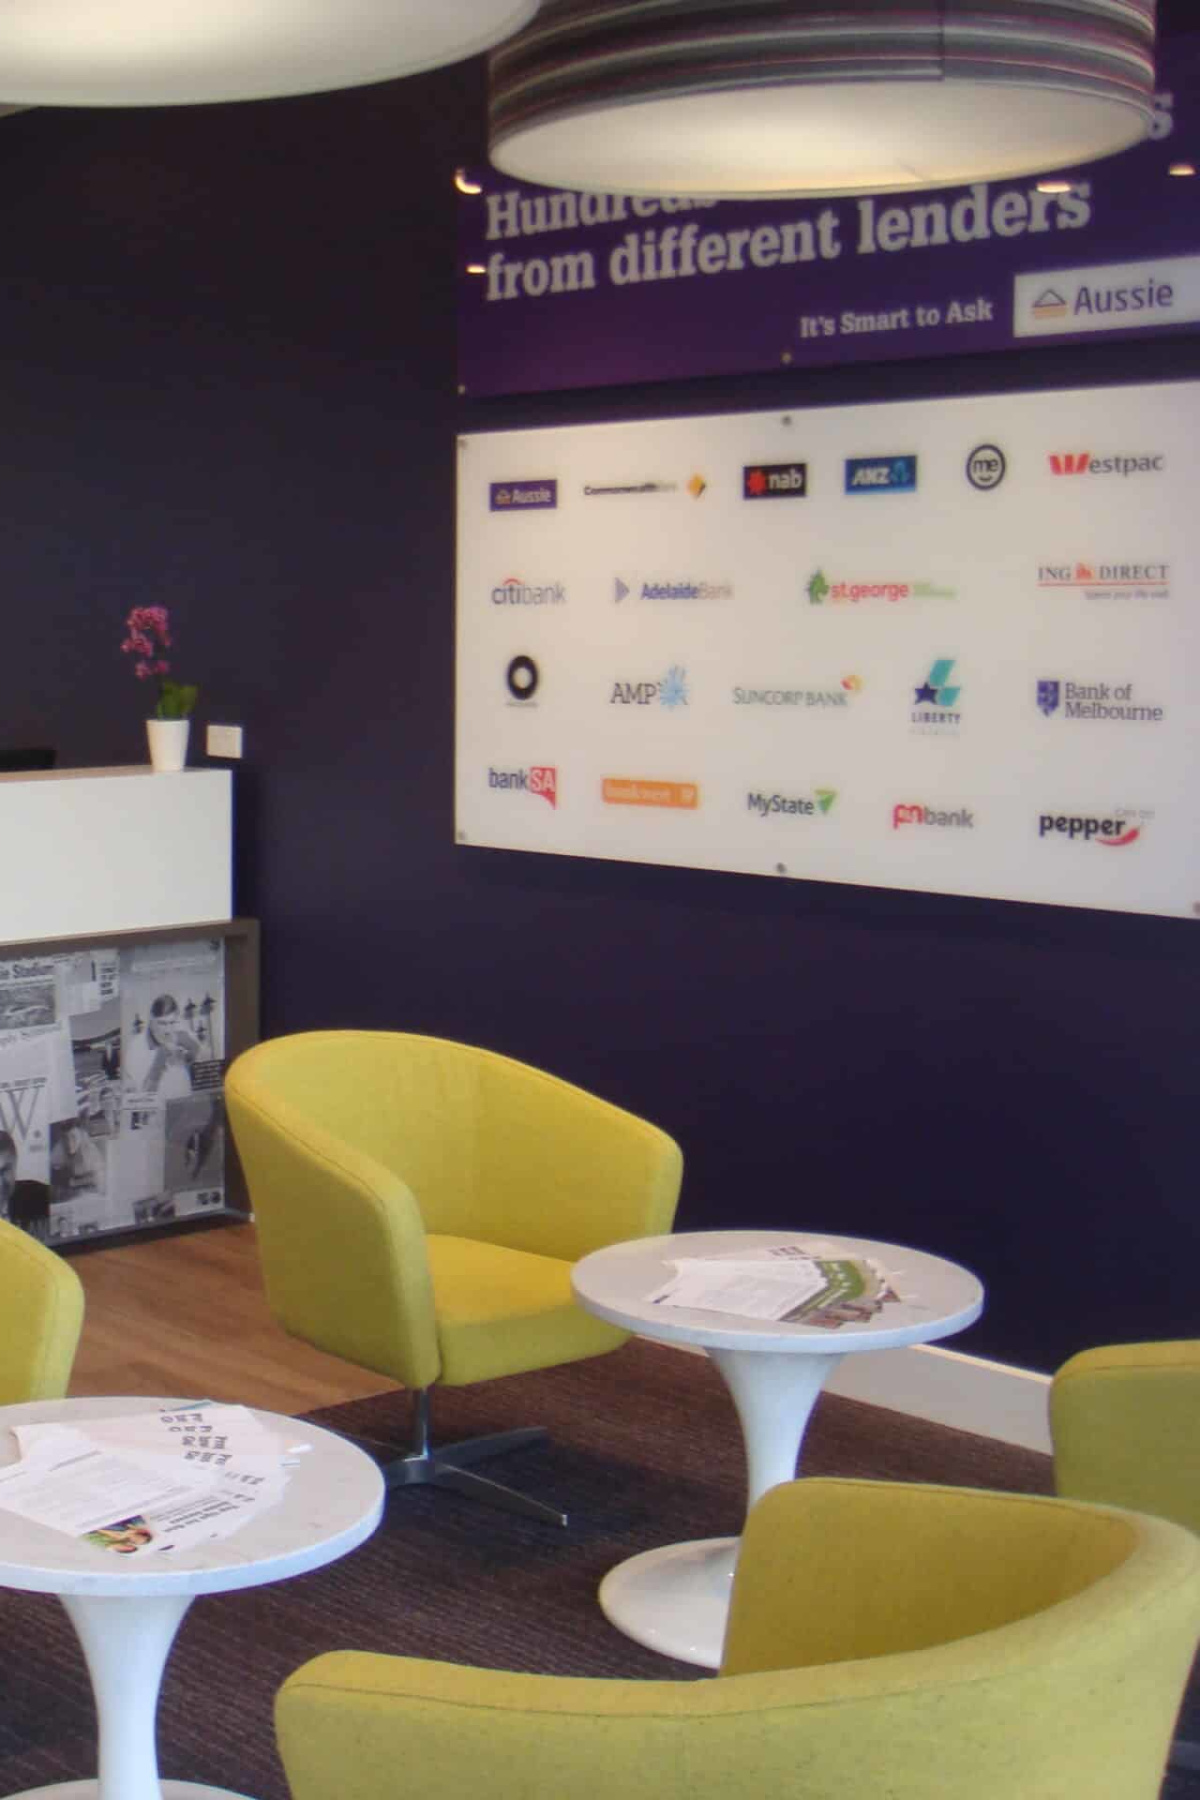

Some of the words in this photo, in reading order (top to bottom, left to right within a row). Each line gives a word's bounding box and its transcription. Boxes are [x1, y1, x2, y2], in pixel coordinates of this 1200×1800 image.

[486, 190, 718, 241] Hundre
[486, 252, 596, 301] from
[609, 206, 842, 286] different
[857, 183, 1091, 255] lenders
[1073, 278, 1174, 316] Aussie
[800, 316, 835, 339] It's
[840, 309, 909, 335] Smart
[916, 303, 940, 328] to
[945, 297, 994, 325] Ask
[972, 457, 1000, 474] me
[1049, 452, 1164, 477] Westpac
[768, 468, 803, 490] nab
[851, 467, 891, 486] ANZ
[1037, 565, 1072, 581] ING
[1099, 563, 1171, 581] DIRECT
[491, 580, 567, 606] citibank
[609, 683, 657, 705] AMP
[1065, 682, 1110, 701] Bank
[1114, 683, 1133, 701] of
[911, 711, 962, 724] LIBERTY
[1065, 701, 1164, 722] Melbourne
[747, 793, 815, 817] MyState
[1039, 813, 1127, 840] pepper
